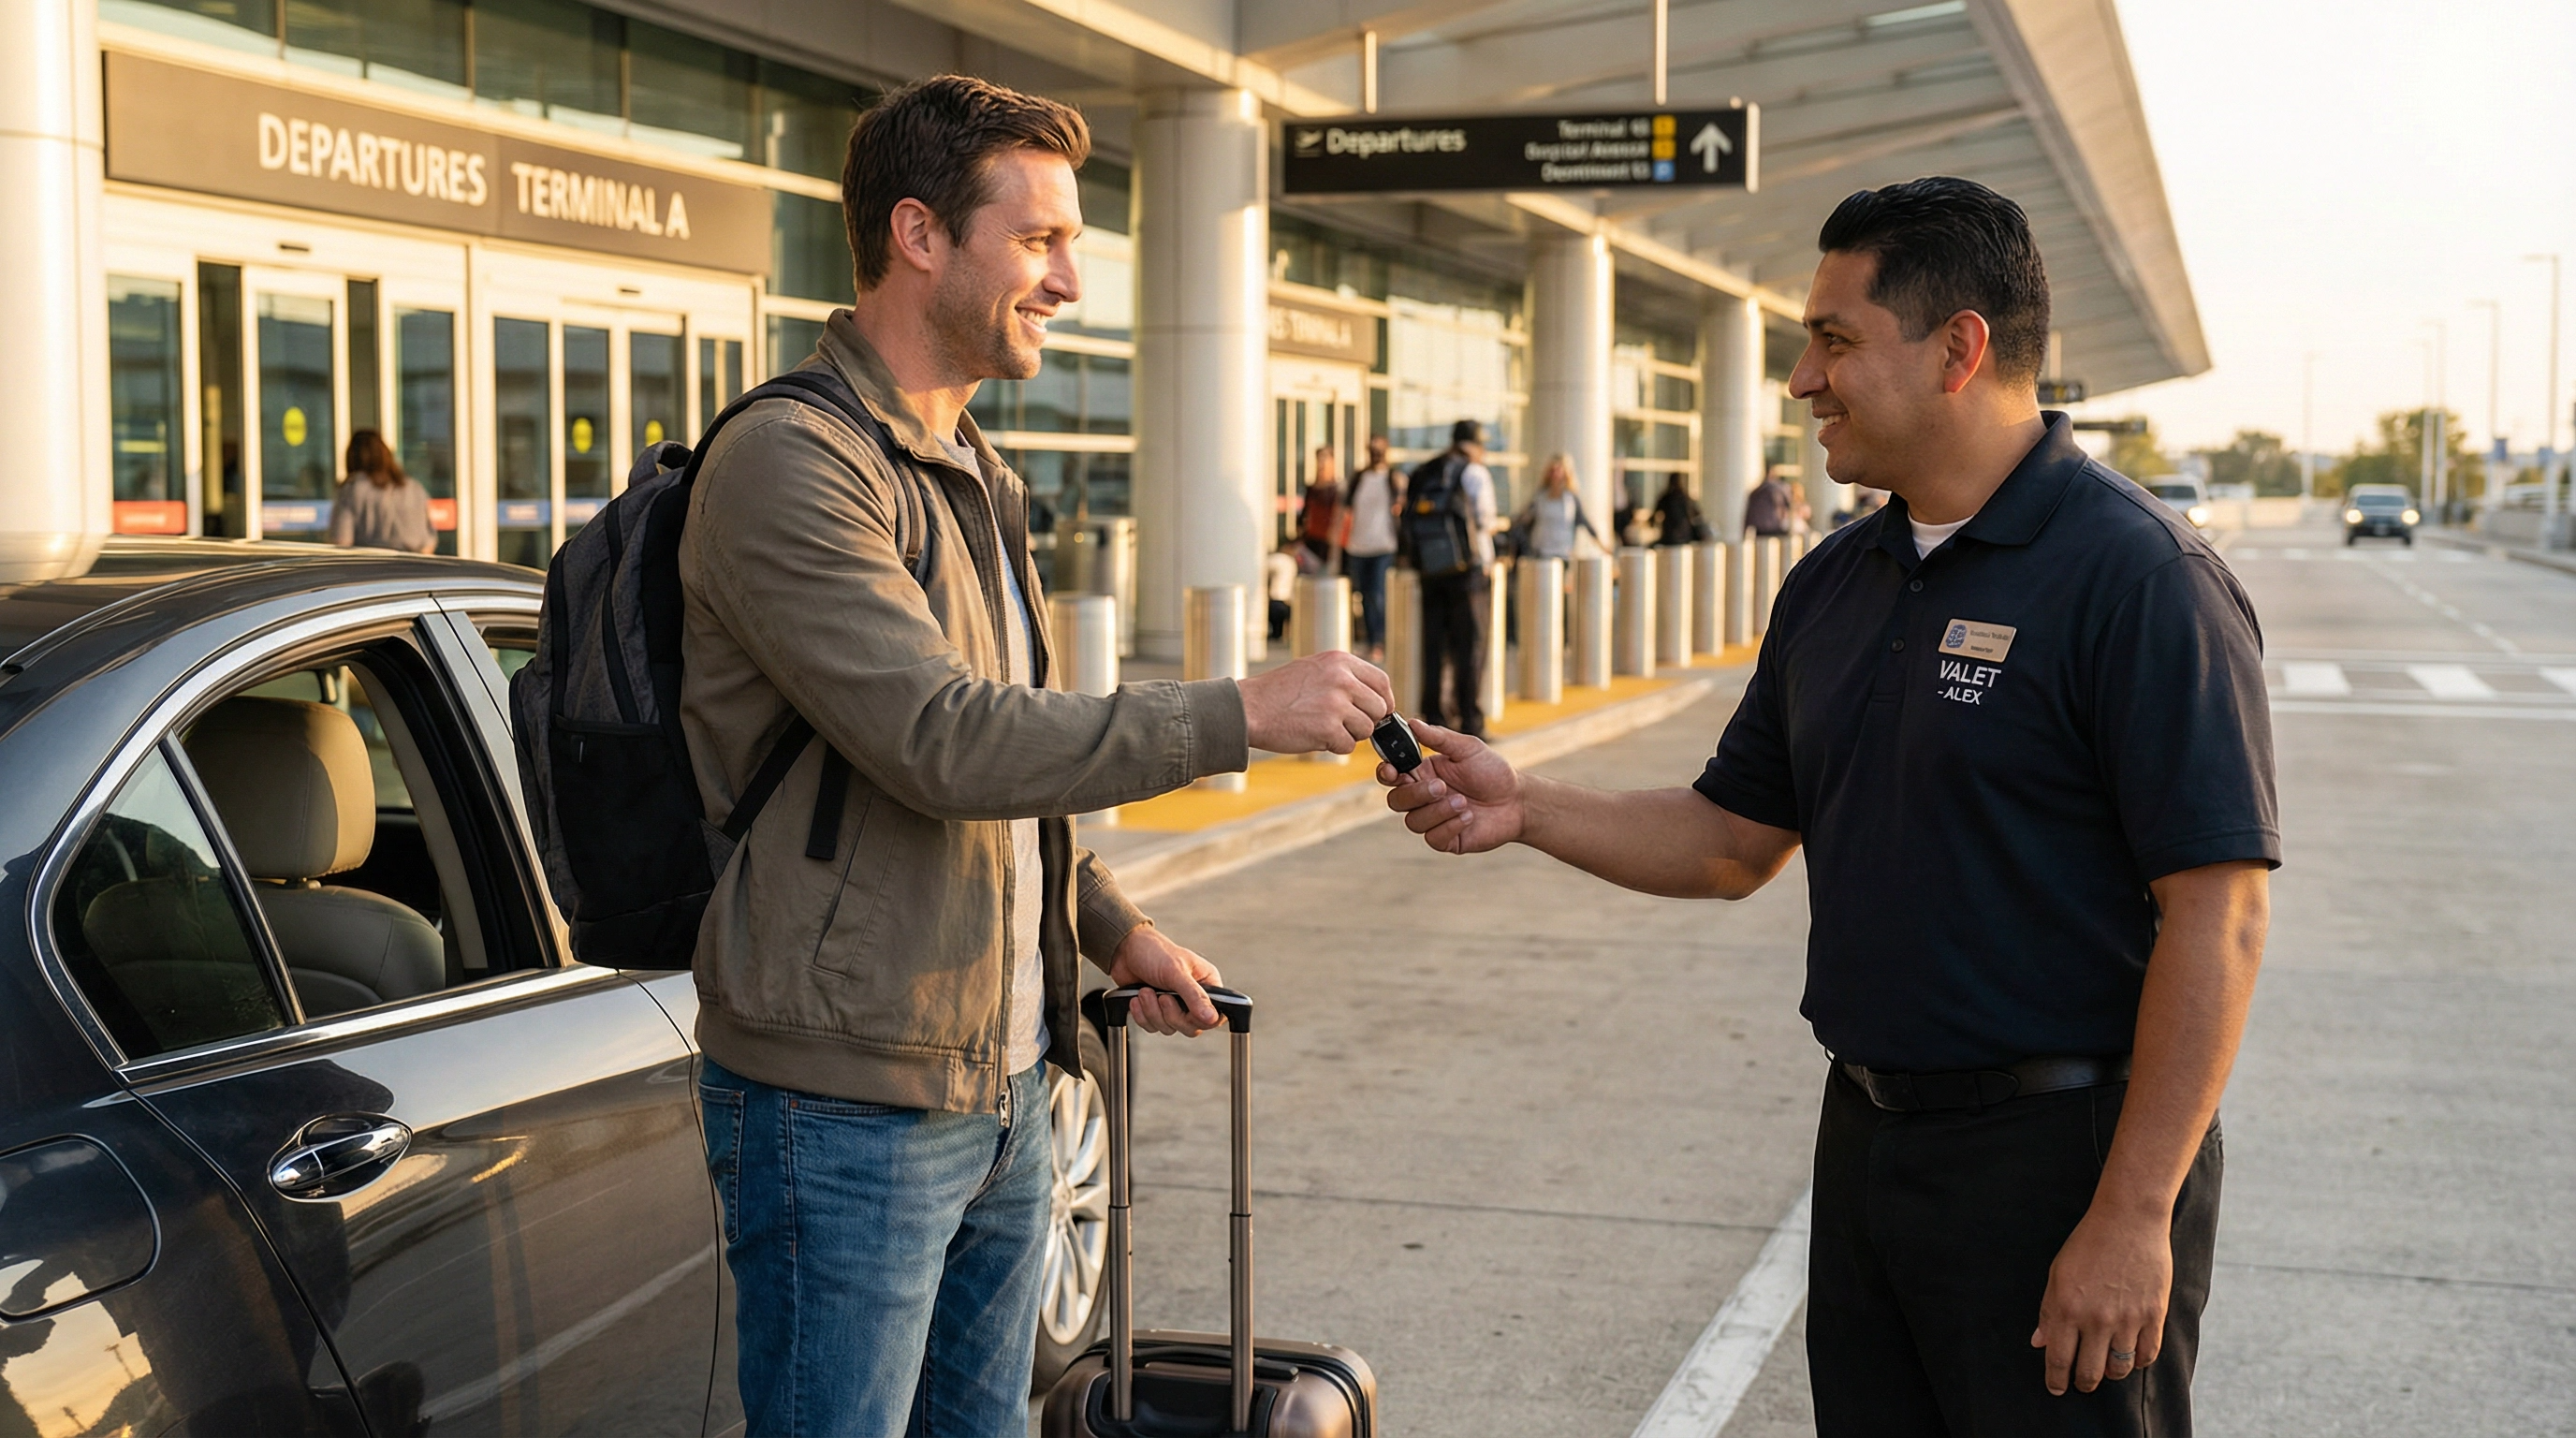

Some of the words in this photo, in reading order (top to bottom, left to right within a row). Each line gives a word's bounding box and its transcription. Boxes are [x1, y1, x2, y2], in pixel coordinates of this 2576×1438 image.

[1325, 126, 1468, 160] Departures
[258, 111, 488, 207] DEPARTURES
[510, 161, 664, 237] TERMINAL
[665, 190, 691, 241] A
[1939, 660, 2001, 687] VALET
